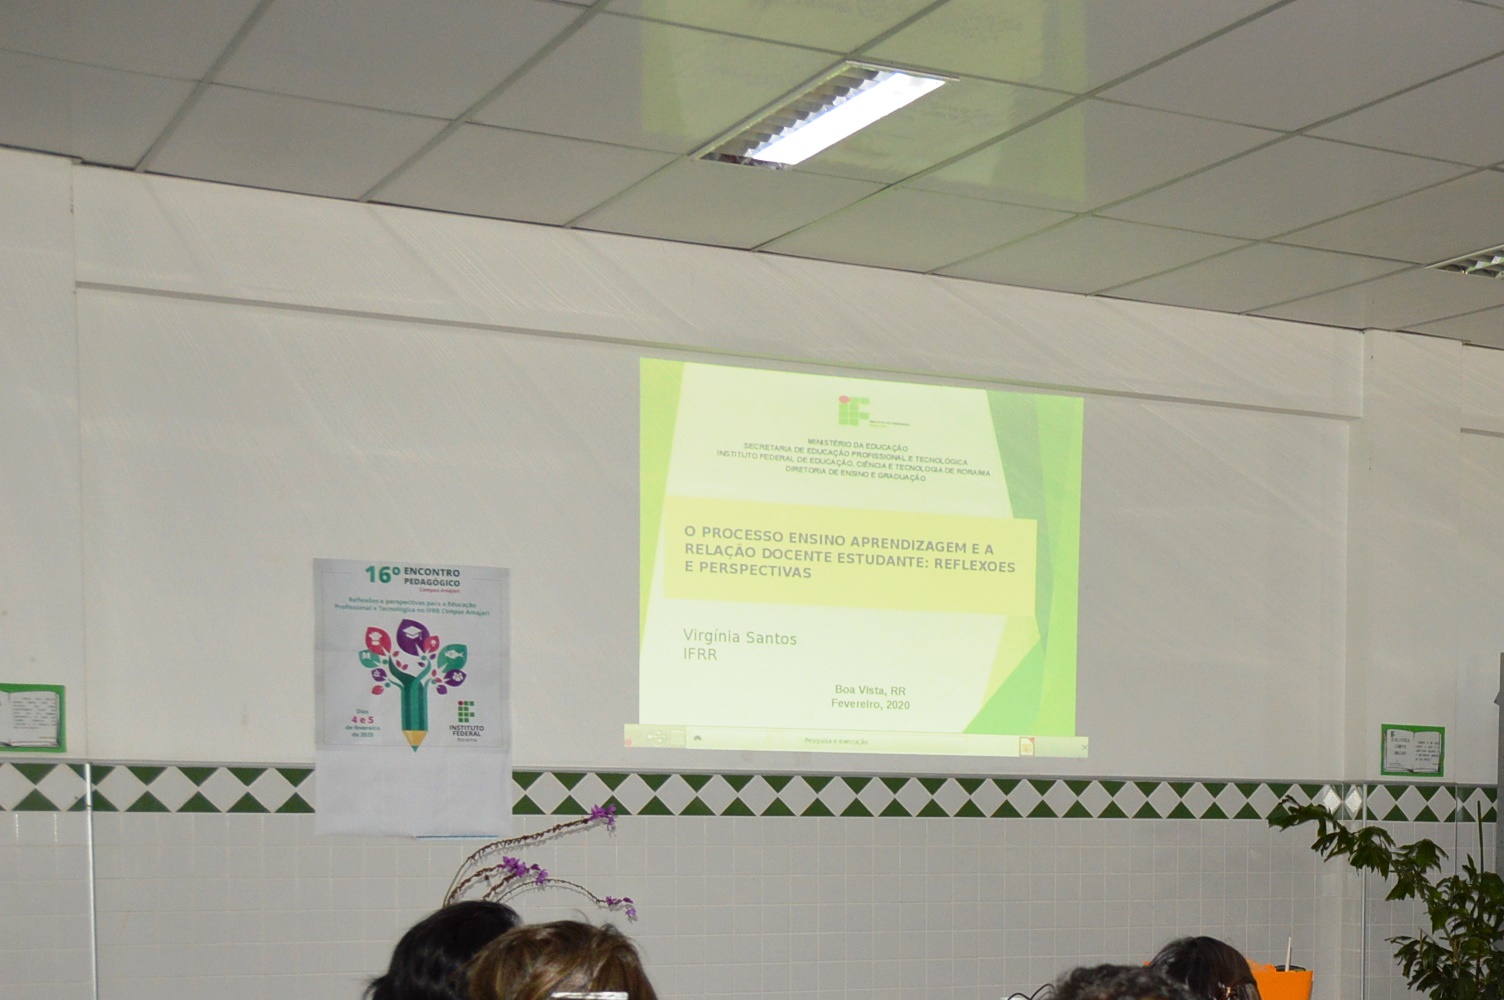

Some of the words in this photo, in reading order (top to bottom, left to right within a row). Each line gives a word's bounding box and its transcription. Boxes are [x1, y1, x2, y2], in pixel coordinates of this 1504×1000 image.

[743, 442, 792, 452] SECRETARIA
[794, 446, 804, 454] DE
[807, 447, 850, 458] EDUCAÇÃO
[851, 451, 906, 462] PROFISSIONAL
[916, 455, 968, 466] TECNOLÓGICA
[808, 438, 852, 448] MINISTÉRIO
[853, 441, 864, 449] DA
[866, 443, 909, 453] EDUCAÇÃO
[717, 450, 758, 459] INSTITUTO
[760, 453, 794, 462] FEDERAL
[797, 456, 808, 464] DE
[856, 460, 887, 469] CIÊNCIA
[895, 463, 943, 474] TECNOLOGIA
[944, 467, 954, 475] DE
[956, 468, 991, 476] RORAIMA
[785, 465, 826, 475] DIRETORIA
[841, 469, 869, 478] ENSINO
[877, 472, 926, 483] GRADUAÇÃO
[684, 525, 696, 537] O
[702, 526, 784, 543] PROCESSO
[789, 532, 846, 546] ENSINO
[850, 536, 967, 553] APRENDIZAGEM
[971, 543, 980, 555] E
[984, 544, 994, 555] A
[685, 543, 756, 560] RELAÇÃO
[762, 548, 832, 563] DOCENTE
[837, 552, 929, 569] ESTUDANTE:
[934, 558, 1016, 573] REFLEXOES
[404, 567, 460, 577] ENCONTRO
[685, 560, 693, 572] E
[699, 561, 812, 579] PERSPECTIVAS
[404, 577, 460, 587] PEDAGÓGICO
[683, 628, 740, 645] Virgínia
[746, 631, 797, 645] Santos
[684, 647, 718, 660] IFRR
[835, 684, 856, 694] Boa
[859, 685, 887, 697] Vista,
[890, 686, 906, 696] RR
[831, 698, 883, 711] Fevereiro,
[886, 700, 910, 710] 2020
